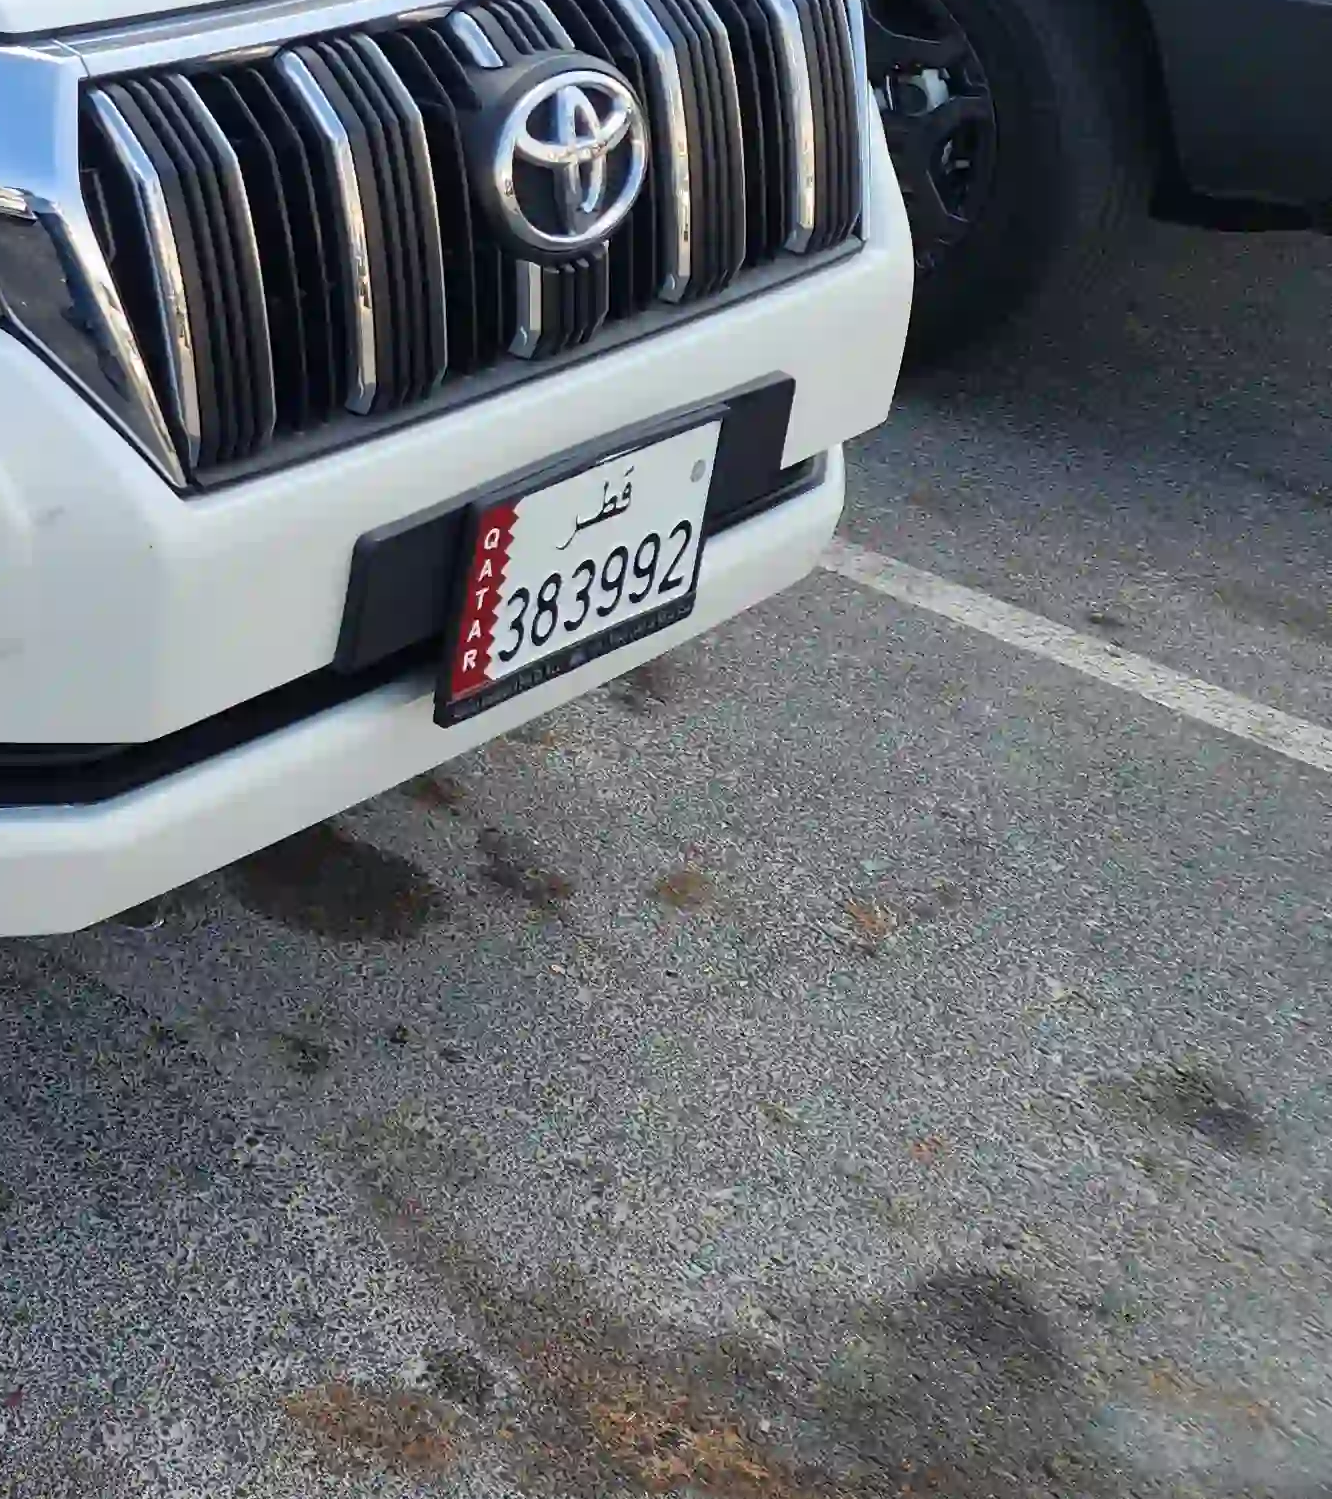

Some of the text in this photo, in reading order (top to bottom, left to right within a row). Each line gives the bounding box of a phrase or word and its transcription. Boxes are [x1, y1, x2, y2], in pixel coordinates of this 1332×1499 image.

[555, 465, 634, 551] قطر
[462, 527, 501, 672] QATAR
[497, 520, 692, 662] 383992
